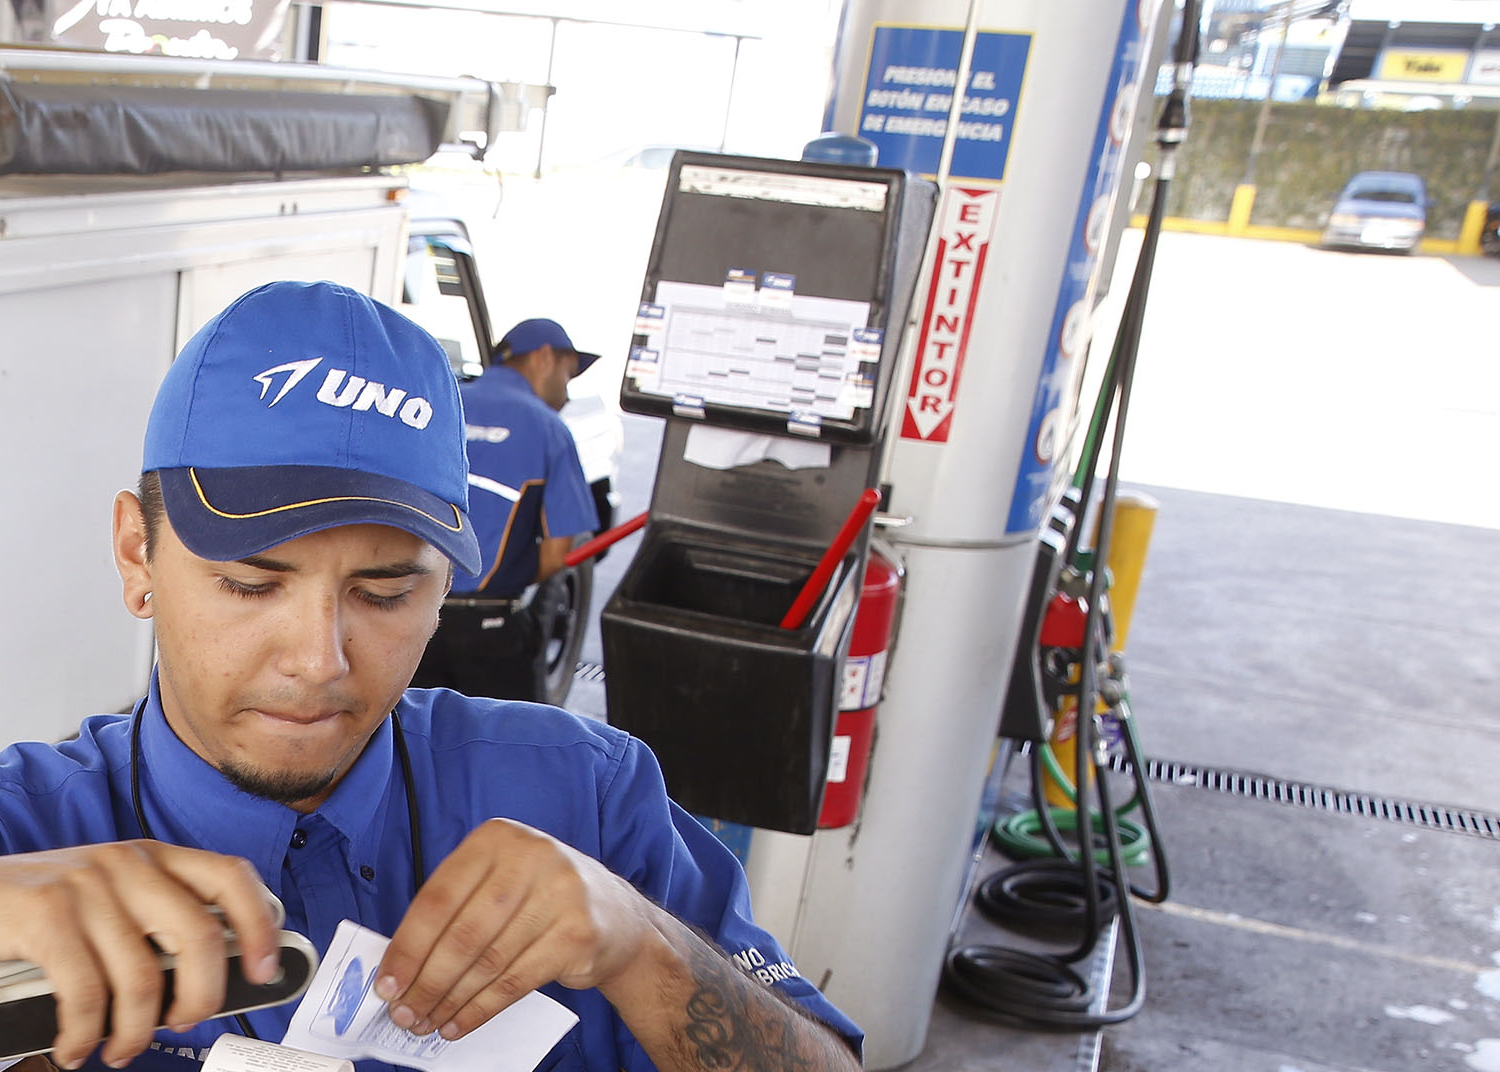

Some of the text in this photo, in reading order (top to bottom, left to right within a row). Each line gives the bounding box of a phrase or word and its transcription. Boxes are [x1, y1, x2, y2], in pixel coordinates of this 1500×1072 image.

[883, 65, 996, 90] PRESION EL
[867, 87, 925, 110] BOTÓN
[863, 113, 1003, 142] DE EMERGNCIA
[920, 203, 981, 416] EXTINTOR
[316, 368, 432, 430] UNO
